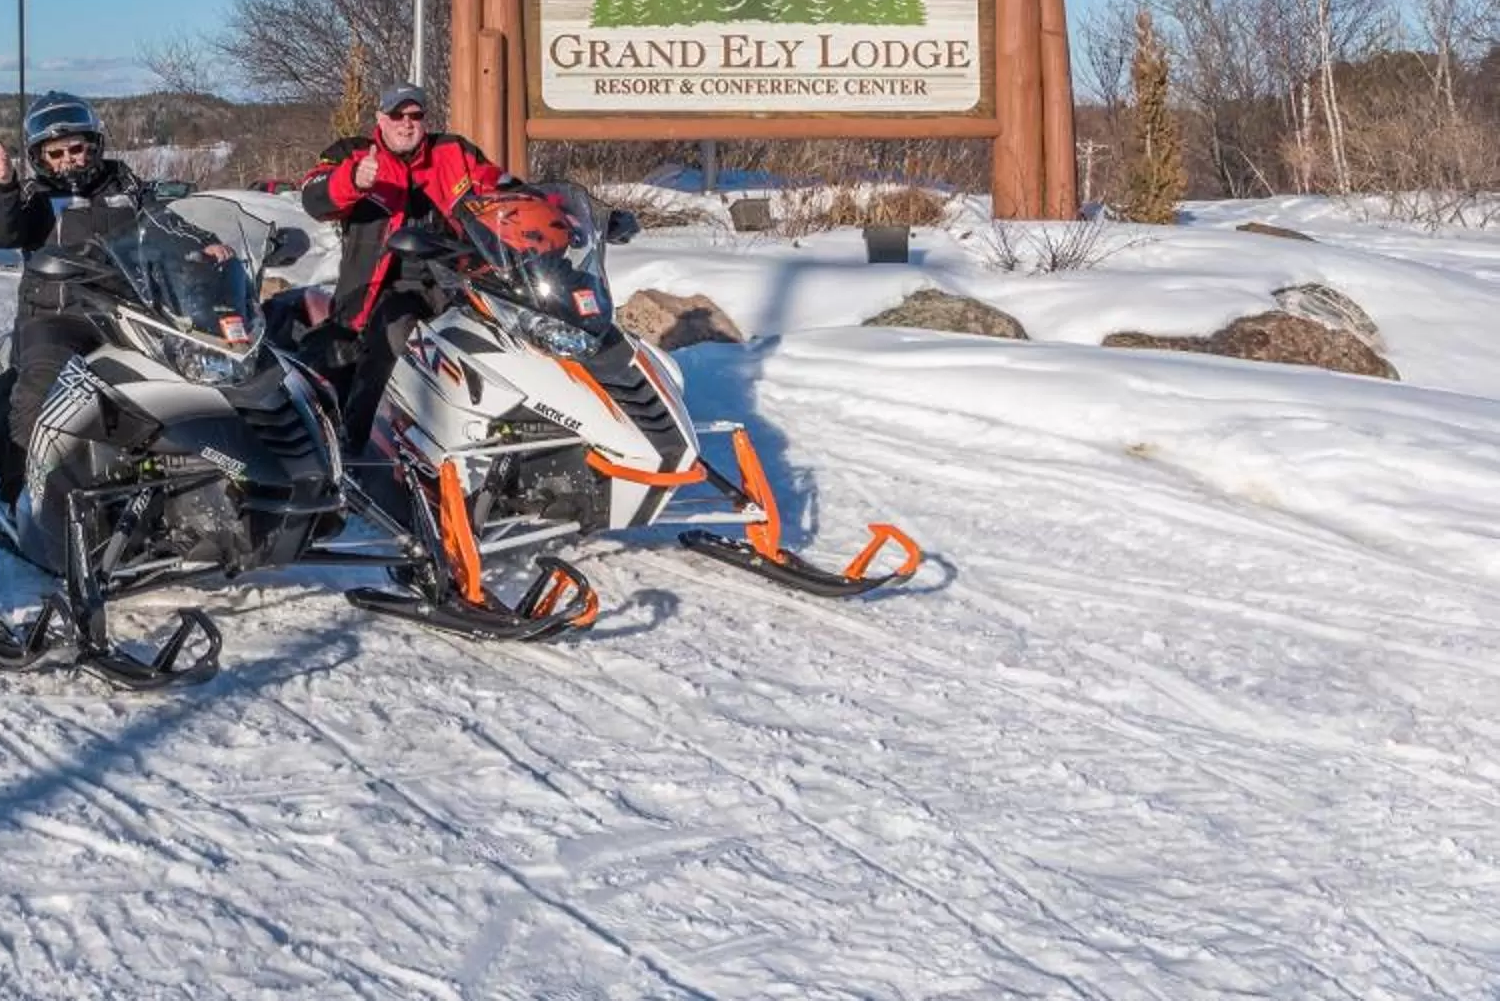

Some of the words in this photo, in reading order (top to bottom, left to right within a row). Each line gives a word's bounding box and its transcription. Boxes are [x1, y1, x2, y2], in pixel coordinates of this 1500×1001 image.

[549, 34, 706, 69] GRAND
[720, 34, 804, 68] ELY
[818, 34, 971, 69] LODGE
[594, 78, 675, 94] RESORT
[679, 78, 695, 94] &
[700, 78, 839, 95] CONFERENCE
[843, 78, 927, 95] CENTER
[533, 401, 564, 422] ARCTIC
[563, 415, 583, 430] CAT
